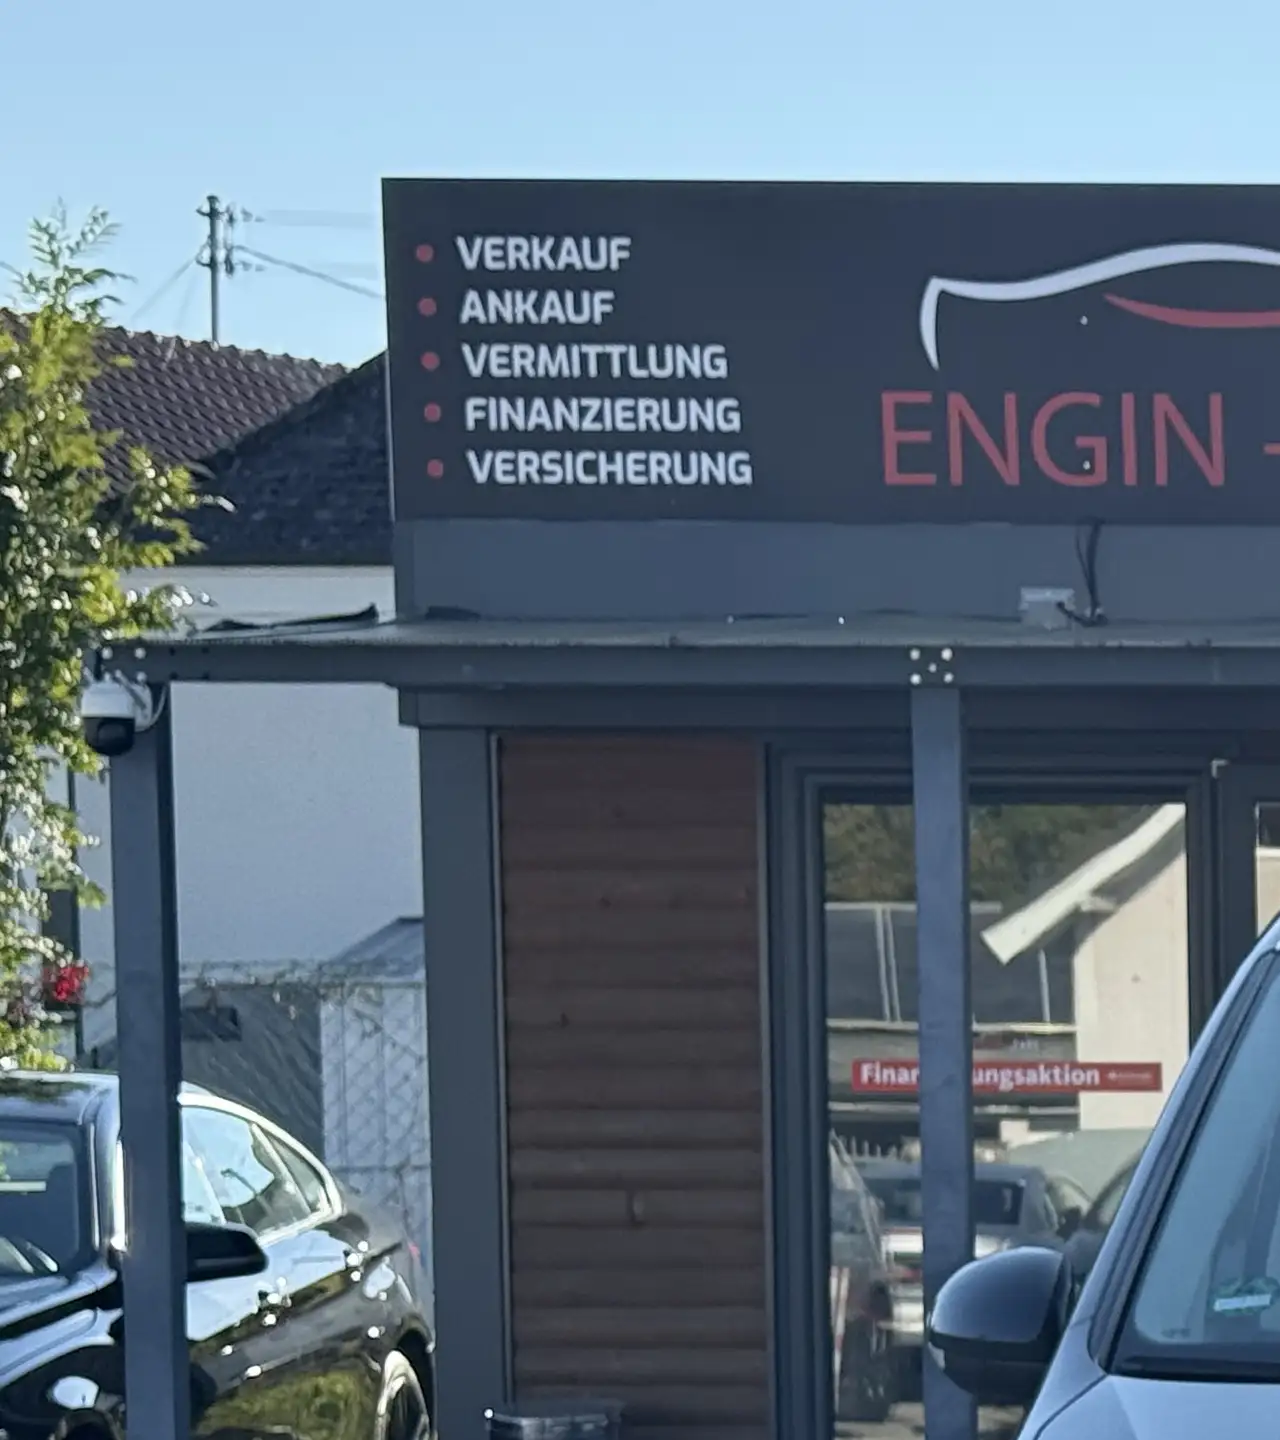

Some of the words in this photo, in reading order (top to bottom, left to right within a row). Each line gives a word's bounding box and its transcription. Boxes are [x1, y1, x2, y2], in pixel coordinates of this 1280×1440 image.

[456, 235, 632, 271] VERKAUF
[460, 289, 615, 325] ANKAUF
[461, 343, 728, 379] VERMITTLUNG
[465, 396, 741, 433] FINANZIERUNG
[880, 390, 1225, 487] ENGIN
[466, 450, 753, 485] VERSICHERUNG
